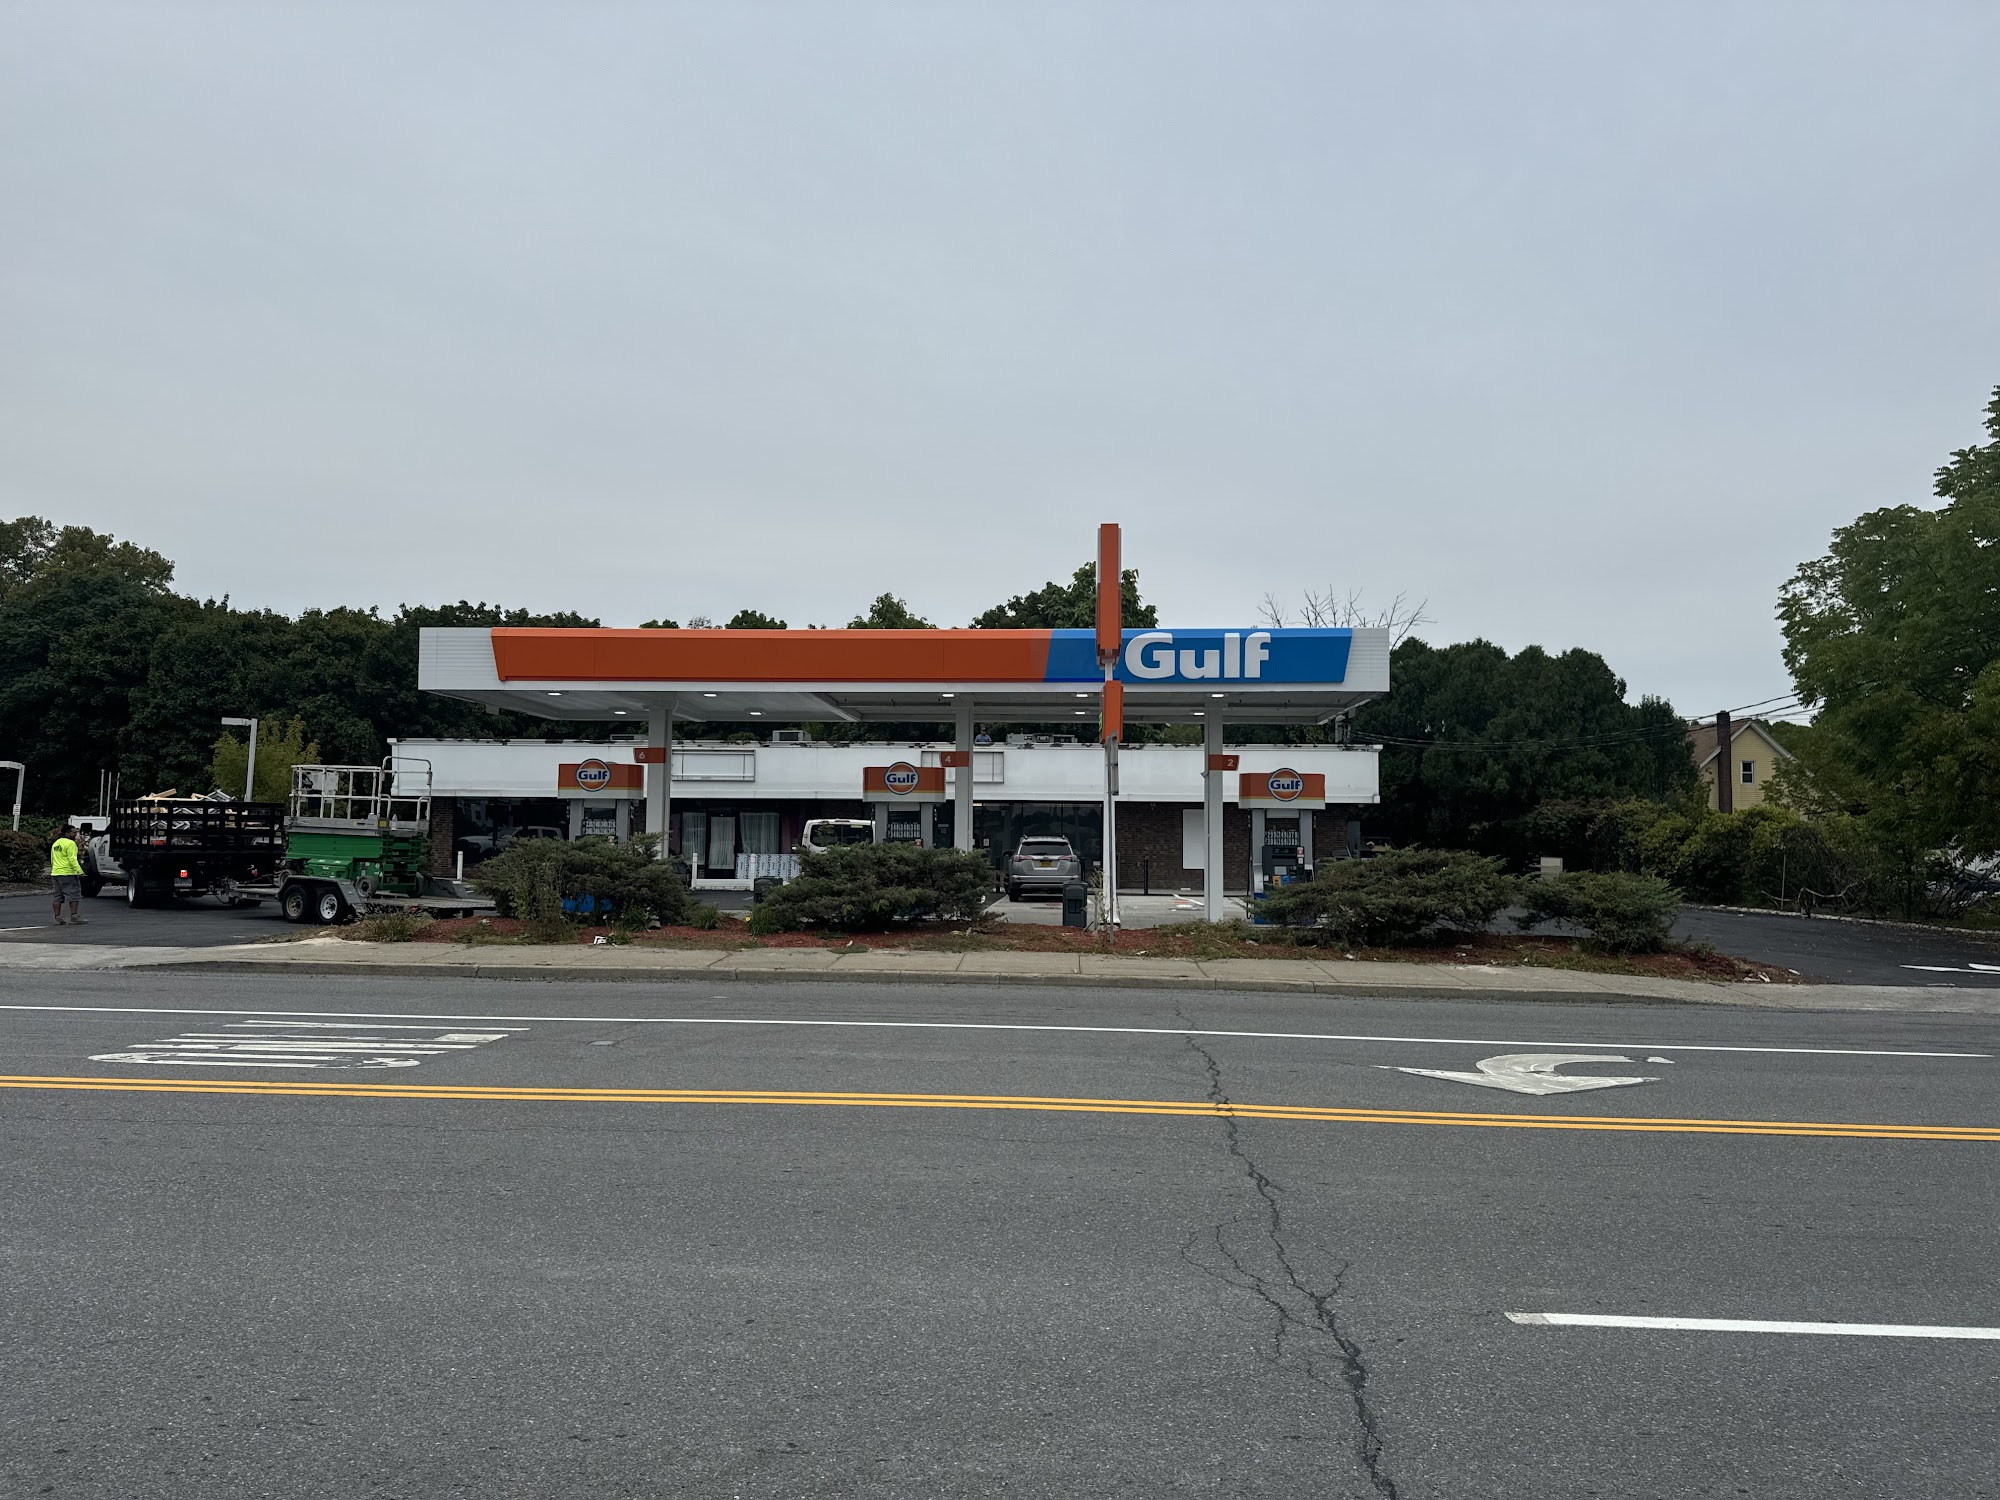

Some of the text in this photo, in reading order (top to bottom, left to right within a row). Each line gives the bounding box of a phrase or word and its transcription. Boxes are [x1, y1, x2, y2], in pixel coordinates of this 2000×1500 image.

[1124, 632, 1271, 679] Gulf
[638, 751, 646, 760] 6
[944, 755, 951, 763] 4
[1227, 758, 1234, 767] 2
[578, 770, 608, 780] Gulf
[886, 773, 916, 783] Gulf
[1270, 779, 1301, 790] Gulf
